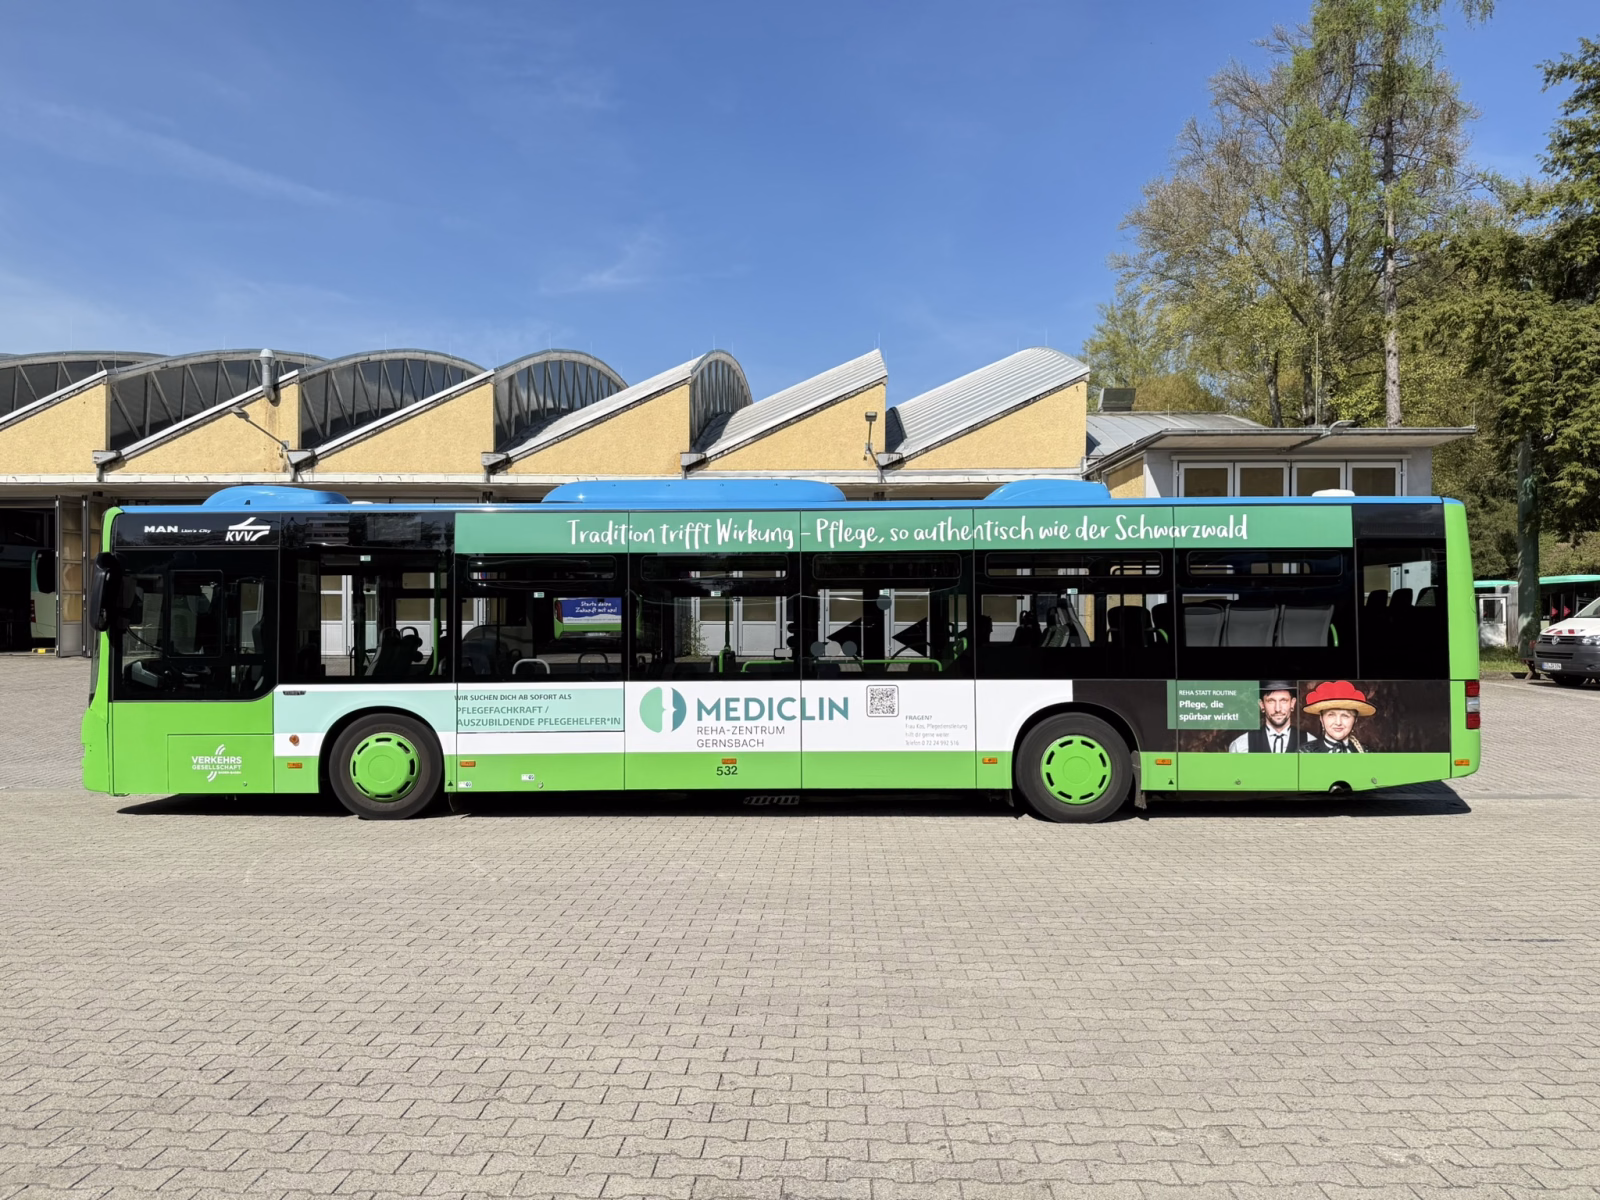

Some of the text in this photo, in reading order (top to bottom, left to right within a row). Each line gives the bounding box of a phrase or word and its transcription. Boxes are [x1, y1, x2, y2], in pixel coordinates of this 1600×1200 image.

[144, 525, 179, 533] MAN
[567, 519, 655, 545] Tradition
[660, 522, 712, 550] trifft
[716, 517, 794, 549] Wirkung
[816, 518, 885, 549] Pflege,
[890, 527, 908, 540] so
[913, 515, 1034, 542] authentisch
[1039, 520, 1071, 540] wie
[1075, 515, 1111, 541] der
[1114, 513, 1248, 541] Schwarzwald
[225, 530, 254, 542] KVV
[457, 706, 543, 714] PFLEGEFACHKRAFT
[696, 696, 849, 722] MEDICLIN
[1179, 700, 1224, 710] Pflege, die
[457, 718, 535, 727] AUSZUBILDENDE
[1179, 713, 1239, 722] spürbar wirkt!
[696, 725, 786, 735] REHA-ZENTRUM
[696, 738, 765, 748] GERNSBACH
[191, 756, 242, 764] VERKEHRS
[716, 765, 738, 776] 532
